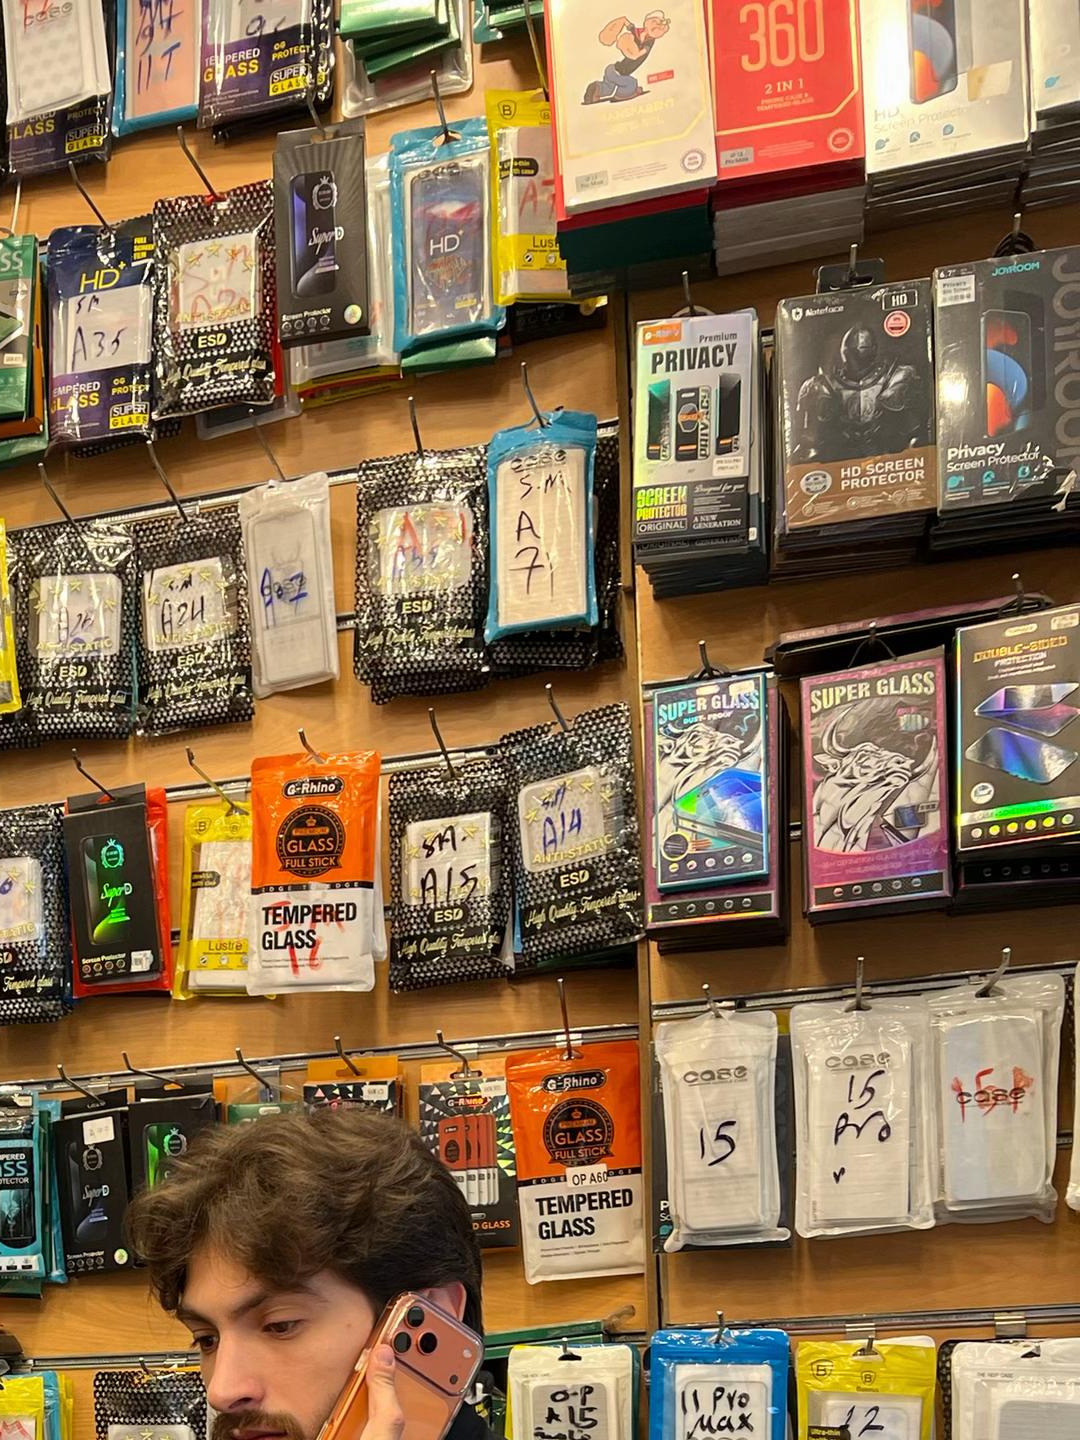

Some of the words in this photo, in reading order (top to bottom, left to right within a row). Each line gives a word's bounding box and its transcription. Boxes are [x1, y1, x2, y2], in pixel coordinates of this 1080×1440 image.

[739, 0, 825, 72] 360
[273, 65, 307, 82] SUPER
[765, 83, 773, 94] 2
[777, 81, 794, 92] IN
[798, 78, 804, 89] 1
[68, 137, 103, 151] GLASS
[992, 261, 1040, 276] JOYROOM
[891, 294, 907, 306] HD
[197, 333, 227, 348] ESD
[699, 332, 738, 343] Premium
[651, 343, 738, 375] PRIVACY
[112, 416, 149, 427] GLASS
[947, 441, 1005, 461] Privacy
[841, 466, 863, 479] HD
[866, 457, 925, 475] SCREEN
[947, 458, 986, 472] Screen
[988, 451, 1040, 468] Protector
[841, 469, 926, 490] PROTECTOR
[636, 504, 687, 521] PROTECTOR
[639, 520, 685, 533] ORIGINAL
[693, 518, 742, 530] GENERATION
[401, 599, 433, 614] ESD
[177, 653, 206, 668] ESD
[60, 667, 88, 678] ESD
[810, 683, 870, 714] SUPER
[876, 671, 935, 697] GLASS
[658, 697, 708, 726] SUPER
[710, 688, 761, 711] GLASS
[286, 779, 336, 796] G-Rhino
[286, 838, 334, 853] GLASS
[285, 857, 307, 868] FULL
[309, 855, 336, 868] STICK
[560, 869, 590, 888] ESD
[261, 902, 357, 926] TEMPERED
[434, 908, 463, 923] ESD
[207, 939, 243, 952] Lustre
[262, 929, 317, 950] GLASS
[825, 1051, 891, 1069] case
[546, 1075, 598, 1090] G-Rhino
[683, 1065, 749, 1084] case
[848, 1069, 885, 1109] 15
[555, 1130, 603, 1146] GLASS
[699, 1120, 737, 1166] 15
[555, 1149, 576, 1160] FULL
[578, 1146, 606, 1158] STICK
[572, 1173, 587, 1186] OP
[589, 1171, 608, 1184] A60
[535, 1188, 634, 1216] TEMPERED
[481, 1219, 511, 1230] GLASS
[538, 1216, 595, 1240] GLASS
